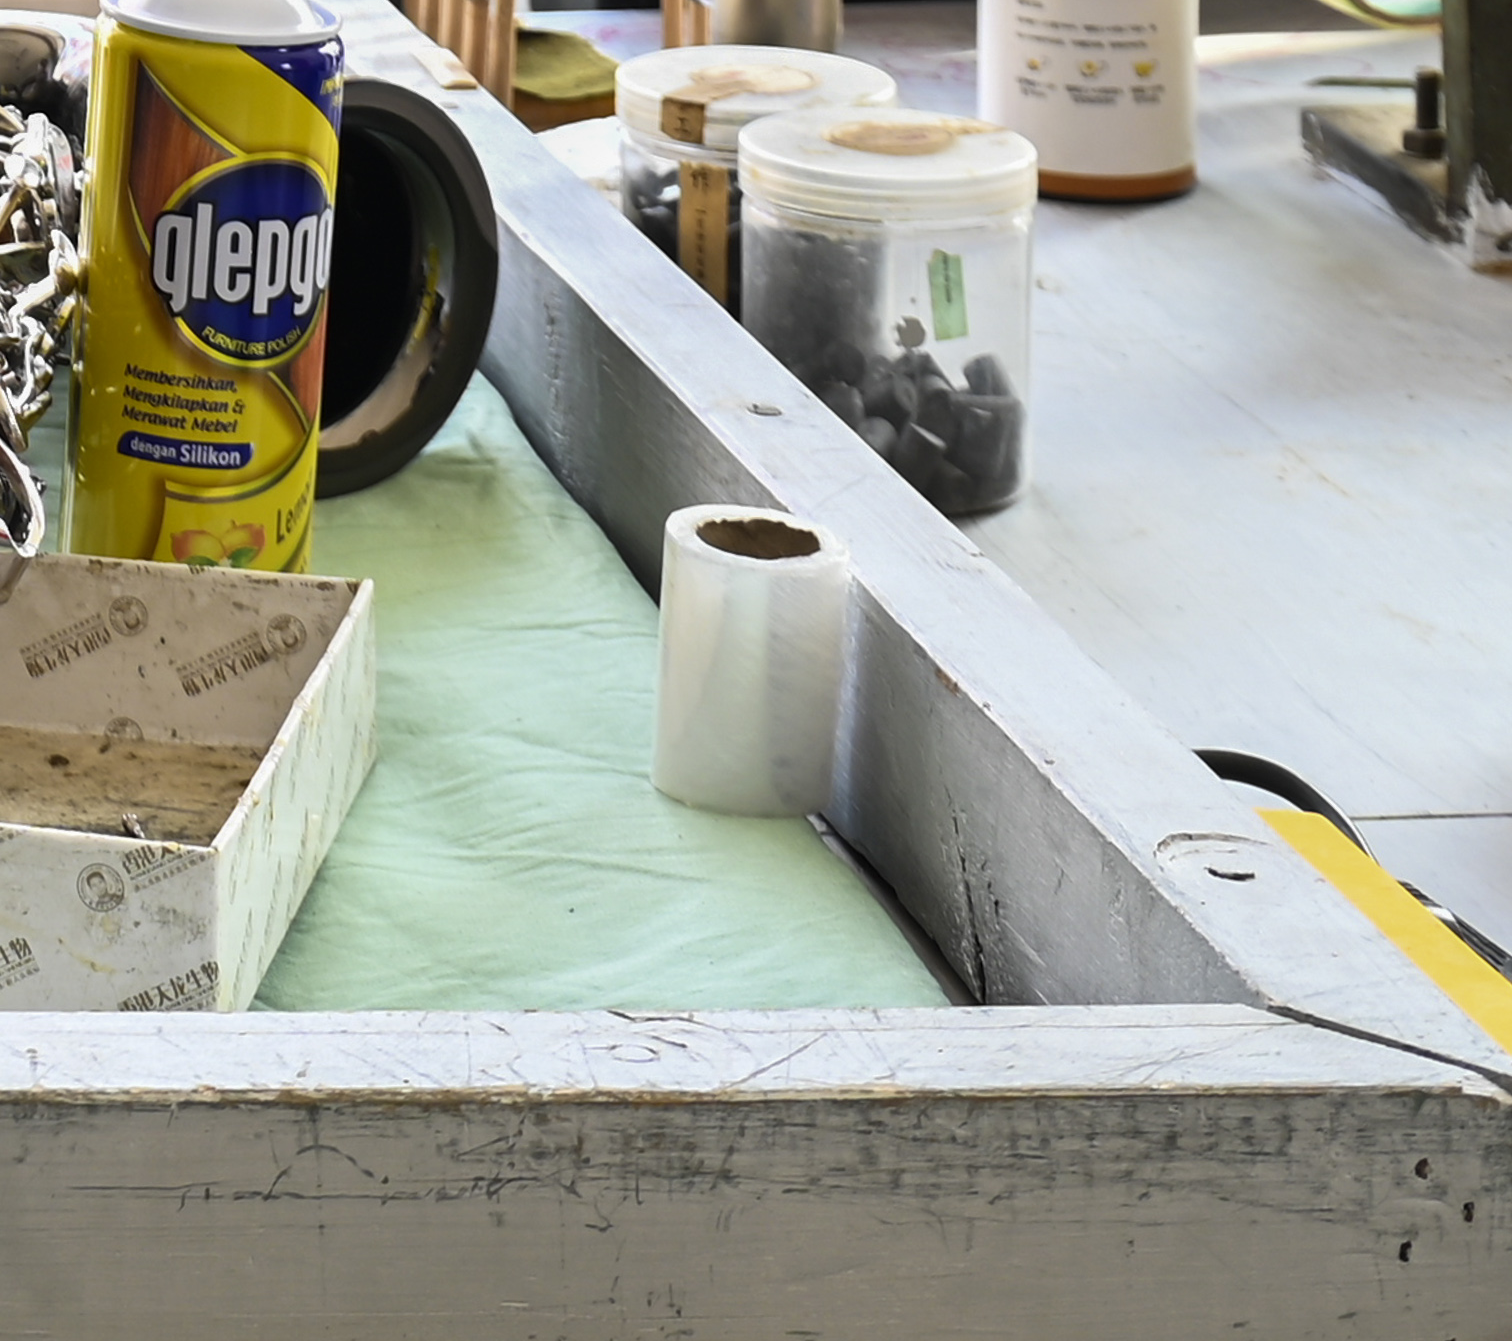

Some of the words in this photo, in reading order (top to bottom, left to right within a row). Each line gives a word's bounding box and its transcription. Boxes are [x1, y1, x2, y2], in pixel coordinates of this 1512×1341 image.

[153, 202, 334, 316] glepgo
[201, 324, 266, 357] FURNITURE
[267, 325, 302, 354] POLISH
[123, 362, 238, 393] Membersihkan,
[122, 384, 229, 414] Mengkilapkan
[231, 399, 246, 415] &
[121, 405, 188, 430] Merawat
[190, 416, 239, 433] Mebel
[129, 435, 177, 460] dengan
[179, 445, 241, 467] Silikon
